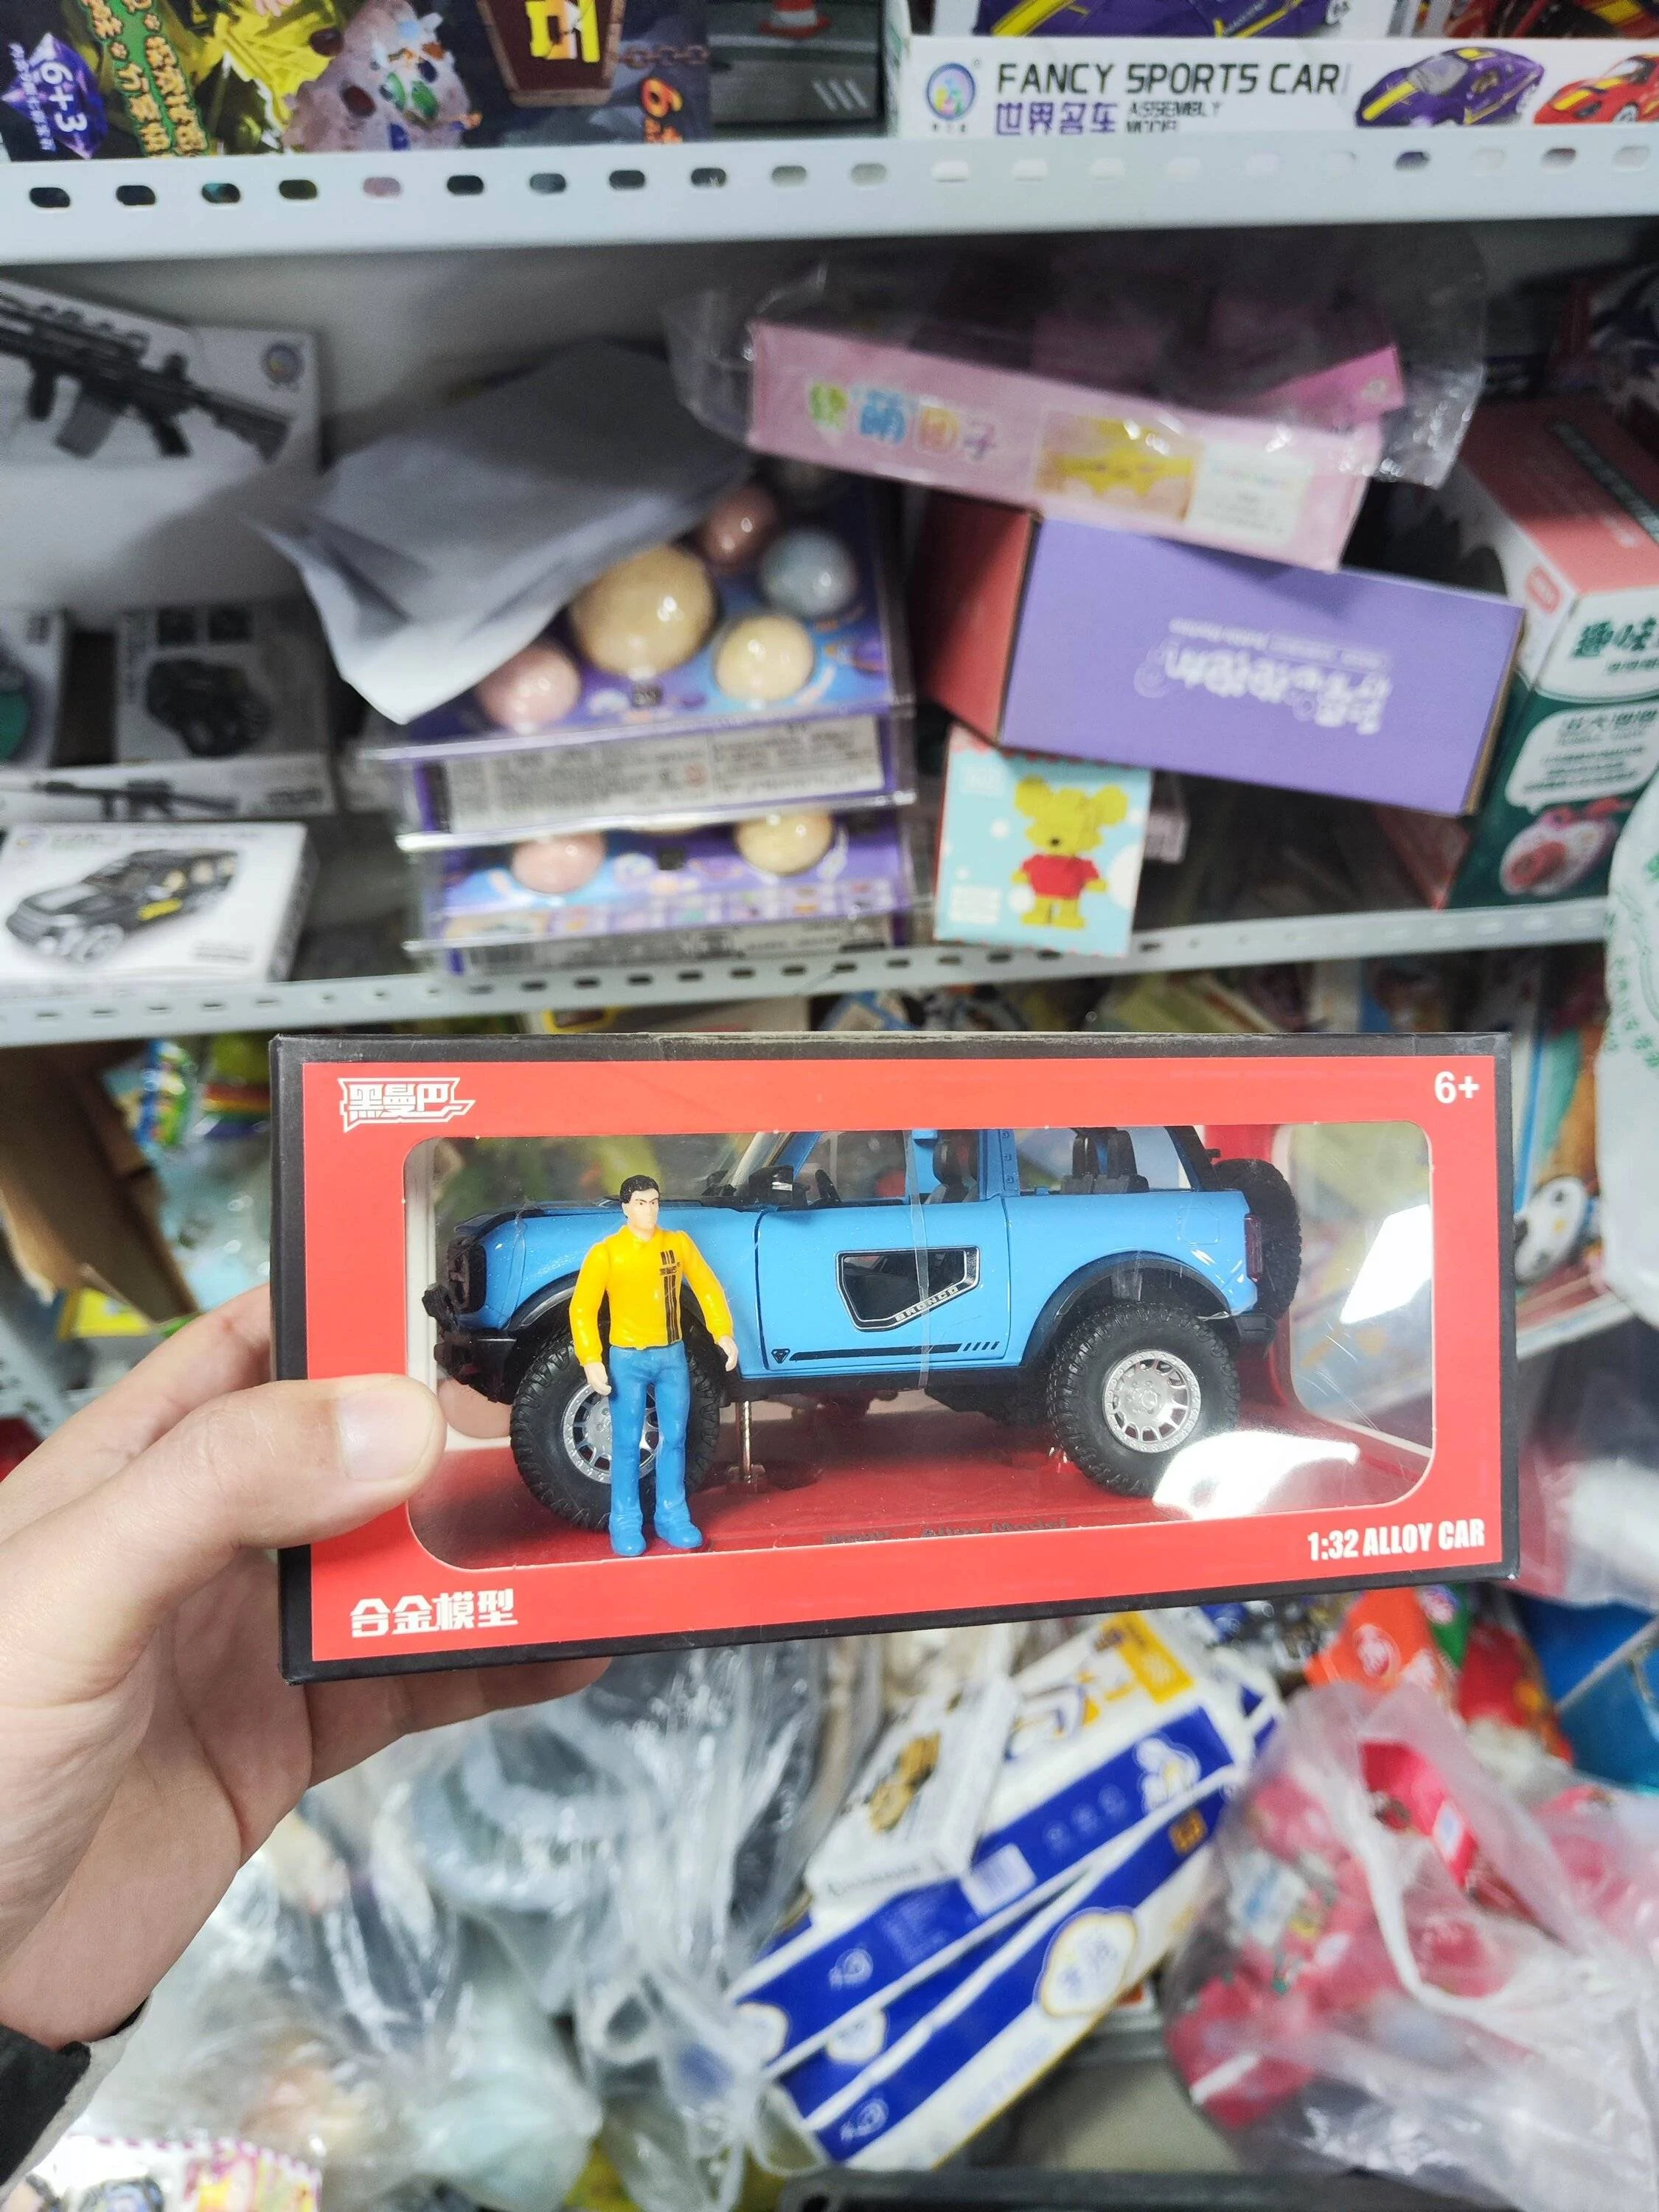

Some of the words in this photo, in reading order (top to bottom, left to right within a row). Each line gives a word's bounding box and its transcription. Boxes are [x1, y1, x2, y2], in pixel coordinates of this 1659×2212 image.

[996, 63, 1113, 94] FANCY
[1125, 63, 1259, 94] SPORTS
[1269, 62, 1341, 94] CAR
[40, 60, 88, 133] 6+3
[1127, 101, 1222, 119] ASSEMBLY
[995, 101, 1118, 135] 世界名车
[349, 1083, 464, 1123] 黑曼巴
[1434, 1070, 1481, 1105] 6+
[894, 1286, 959, 1322] BRONCO
[1307, 1528, 1359, 1562] 1:32
[1362, 1522, 1433, 1557] ALLOY
[1438, 1517, 1486, 1551] CAR
[349, 1588, 519, 1638] 合金模型
